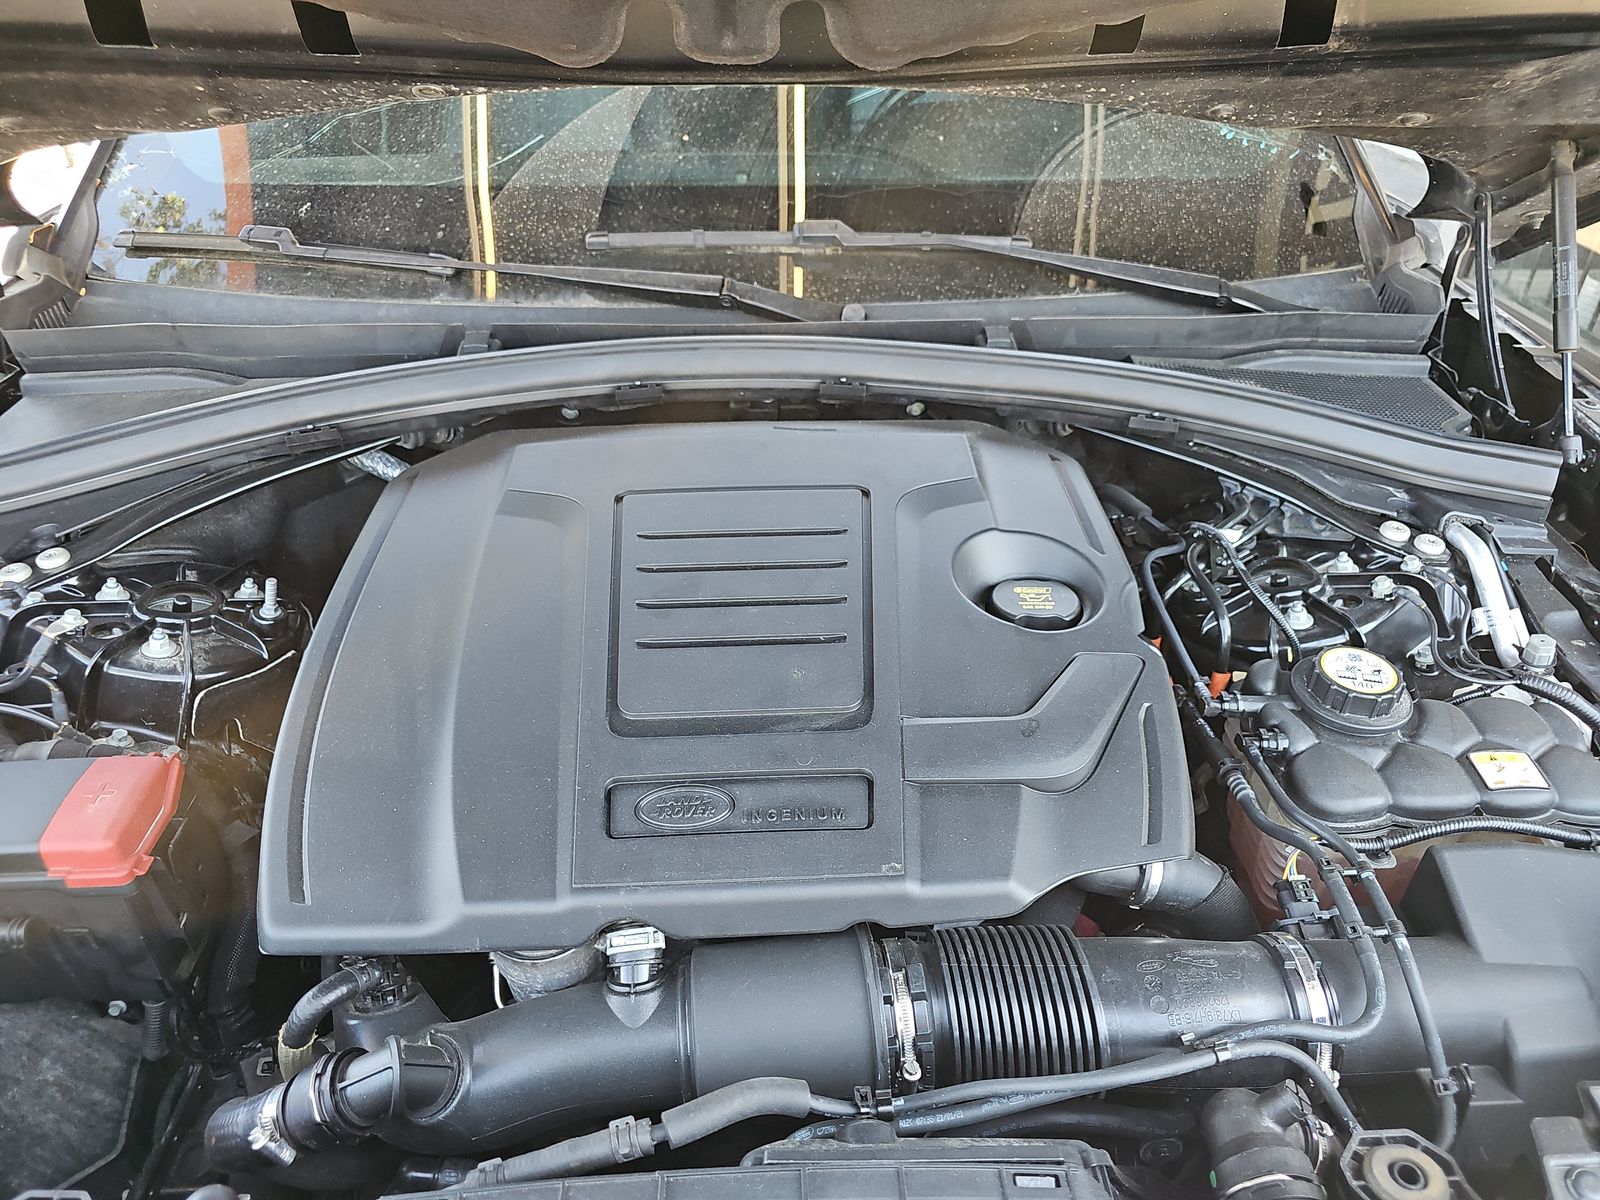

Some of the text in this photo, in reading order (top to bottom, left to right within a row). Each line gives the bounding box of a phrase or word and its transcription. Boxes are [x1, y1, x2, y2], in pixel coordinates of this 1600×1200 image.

[656, 794, 707, 807] LAND
[656, 804, 717, 819] ROVER
[740, 806, 847, 824] INGENIUM
